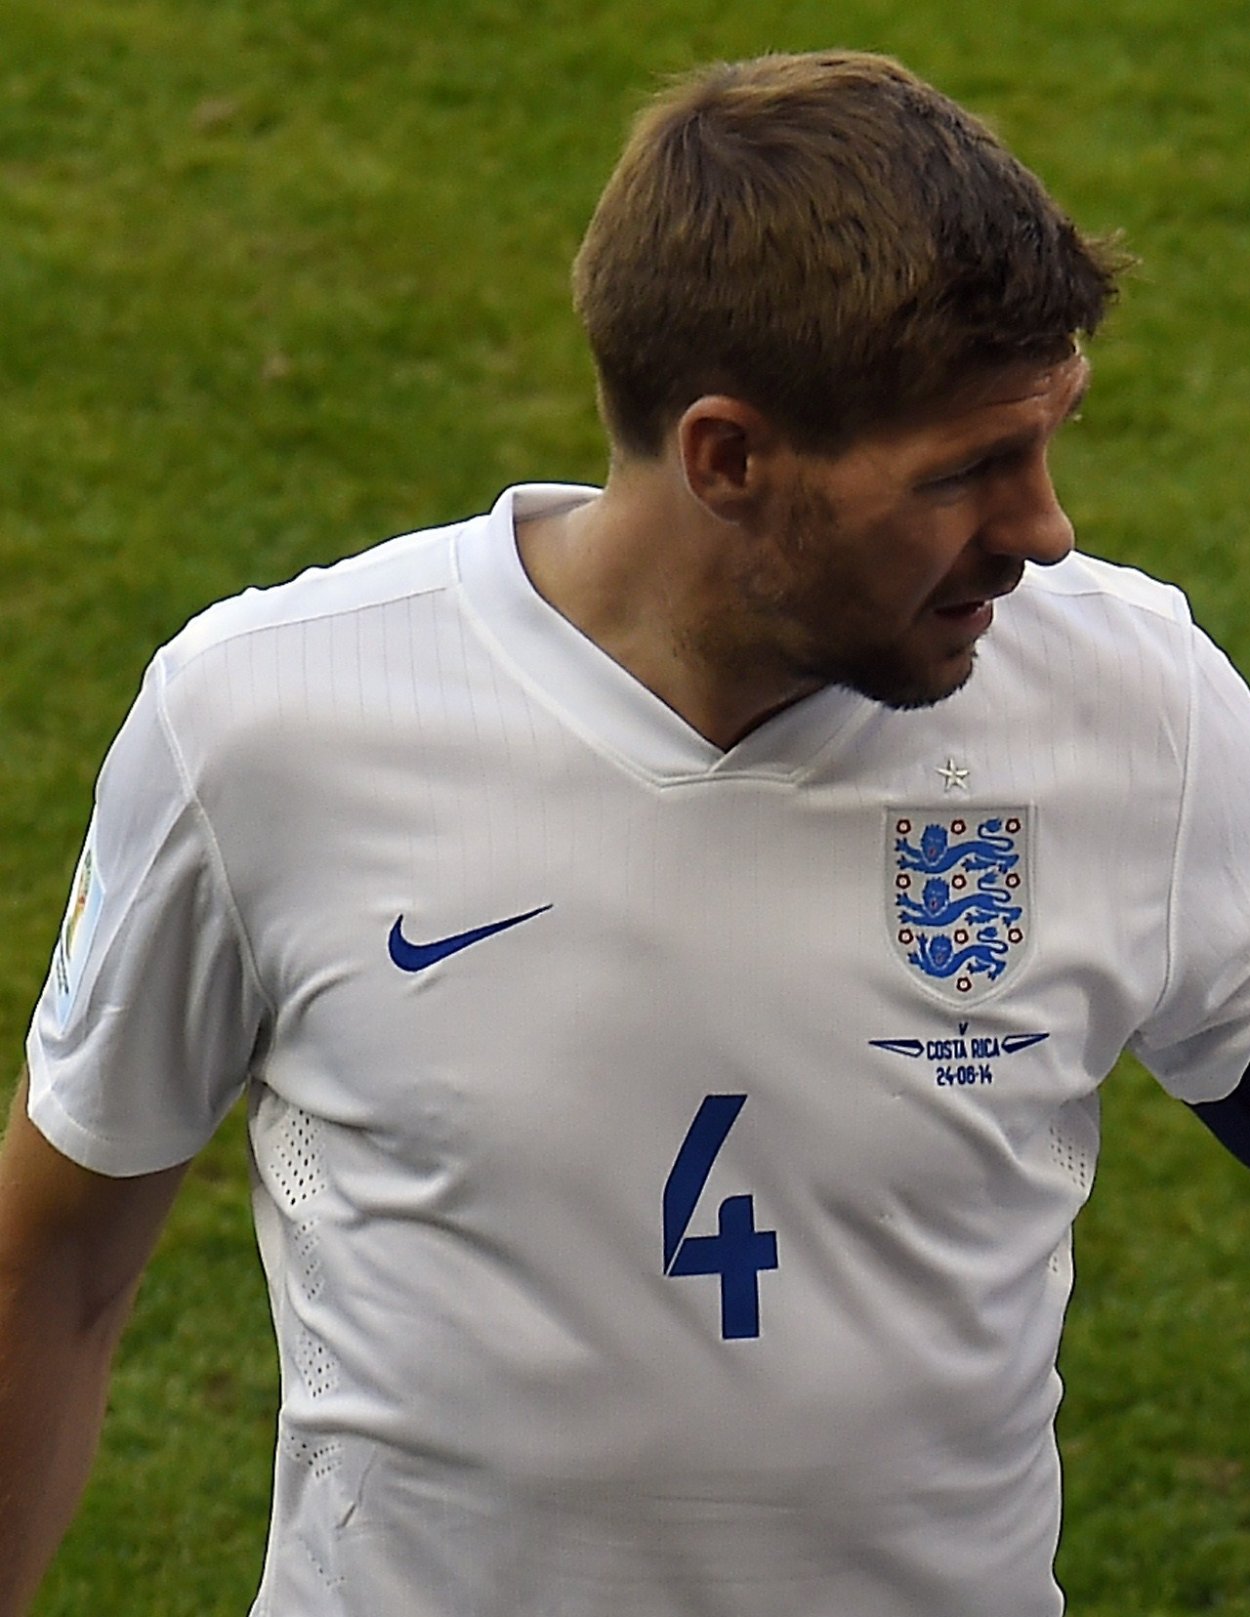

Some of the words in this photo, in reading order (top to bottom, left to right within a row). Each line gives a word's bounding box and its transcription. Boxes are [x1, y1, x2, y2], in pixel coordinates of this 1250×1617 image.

[927, 1040, 967, 1060] COSTA
[971, 1038, 1000, 1059] RICA
[662, 1094, 778, 1340] 4
